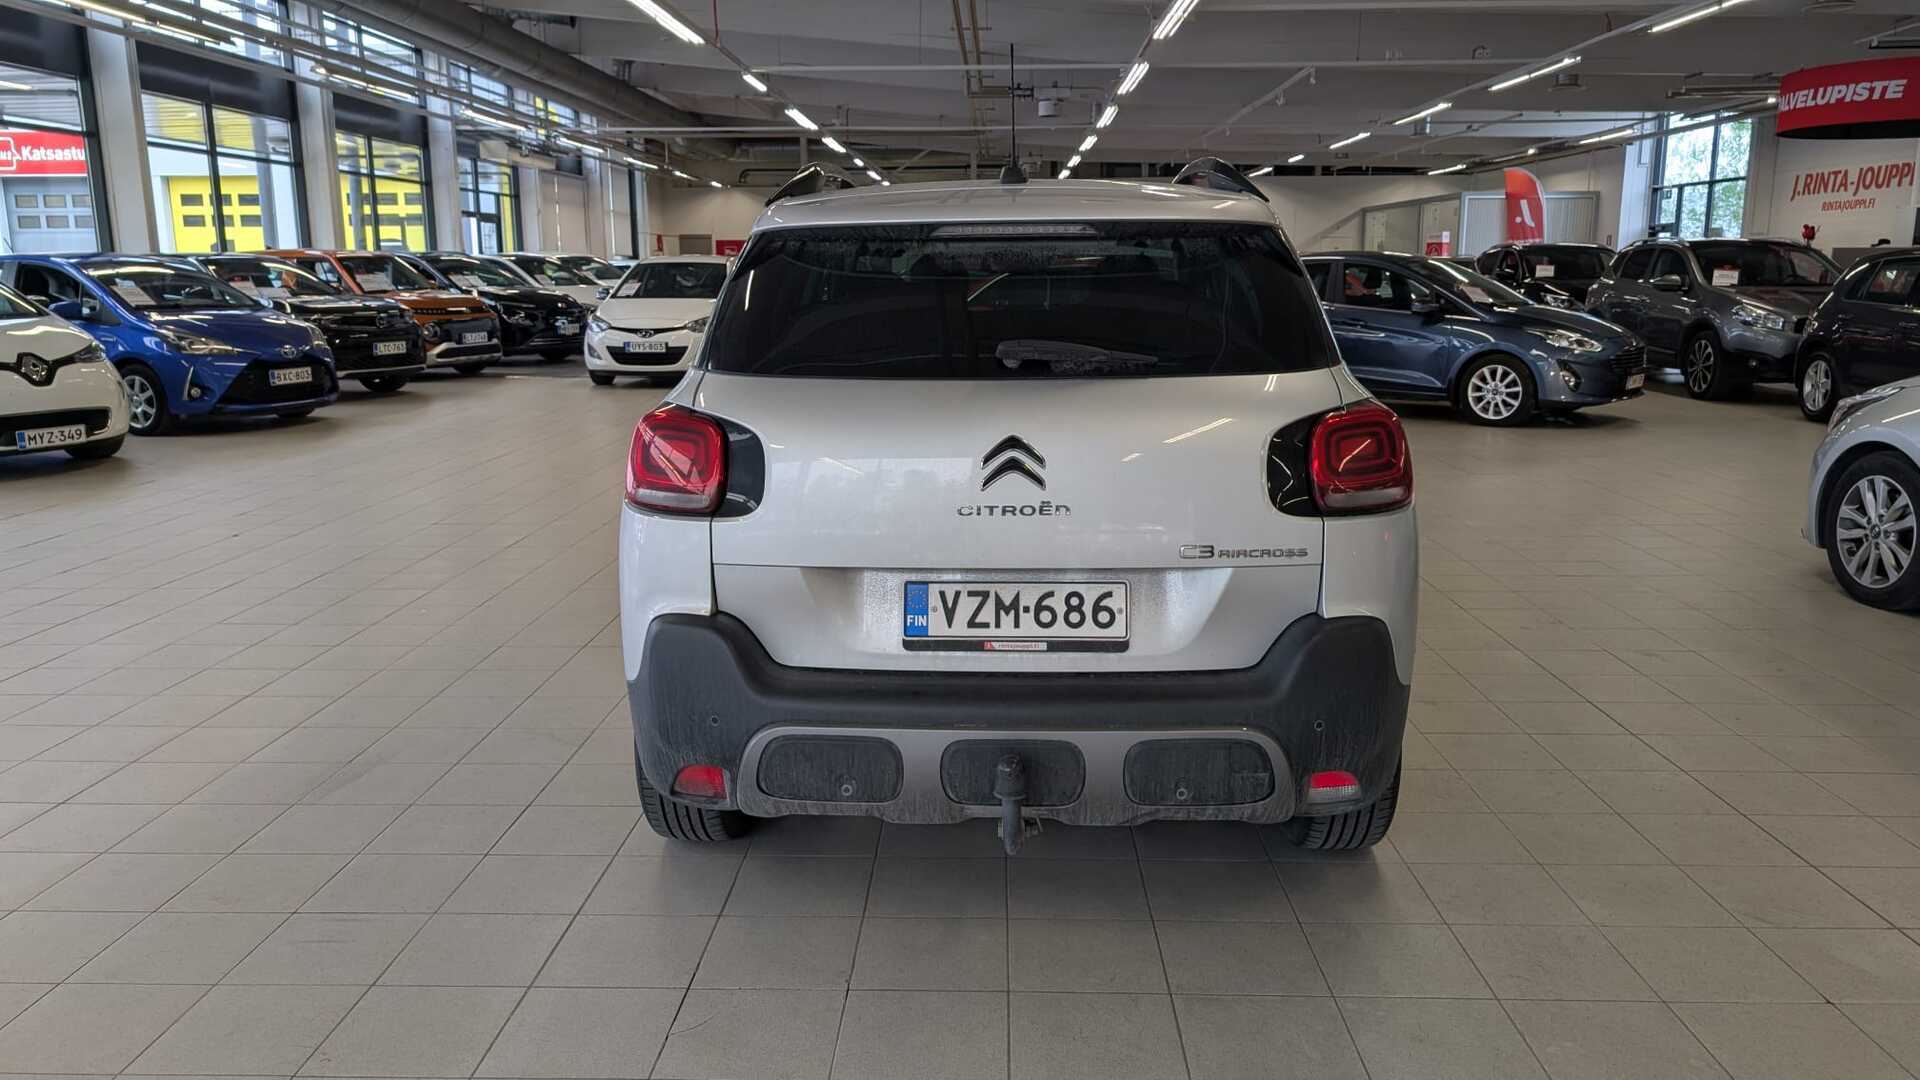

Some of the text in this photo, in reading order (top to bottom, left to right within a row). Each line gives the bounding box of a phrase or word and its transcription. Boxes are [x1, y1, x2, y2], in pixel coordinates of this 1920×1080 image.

[1790, 160, 1916, 201] J.RINTA-JOUPPI
[1821, 197, 1876, 213] RINTAJOUPPI.FI
[26, 428, 83, 446] MYZ-349
[1179, 544, 1309, 559] C3 AIRCROSS
[907, 590, 1117, 629] FIN VZM-686
